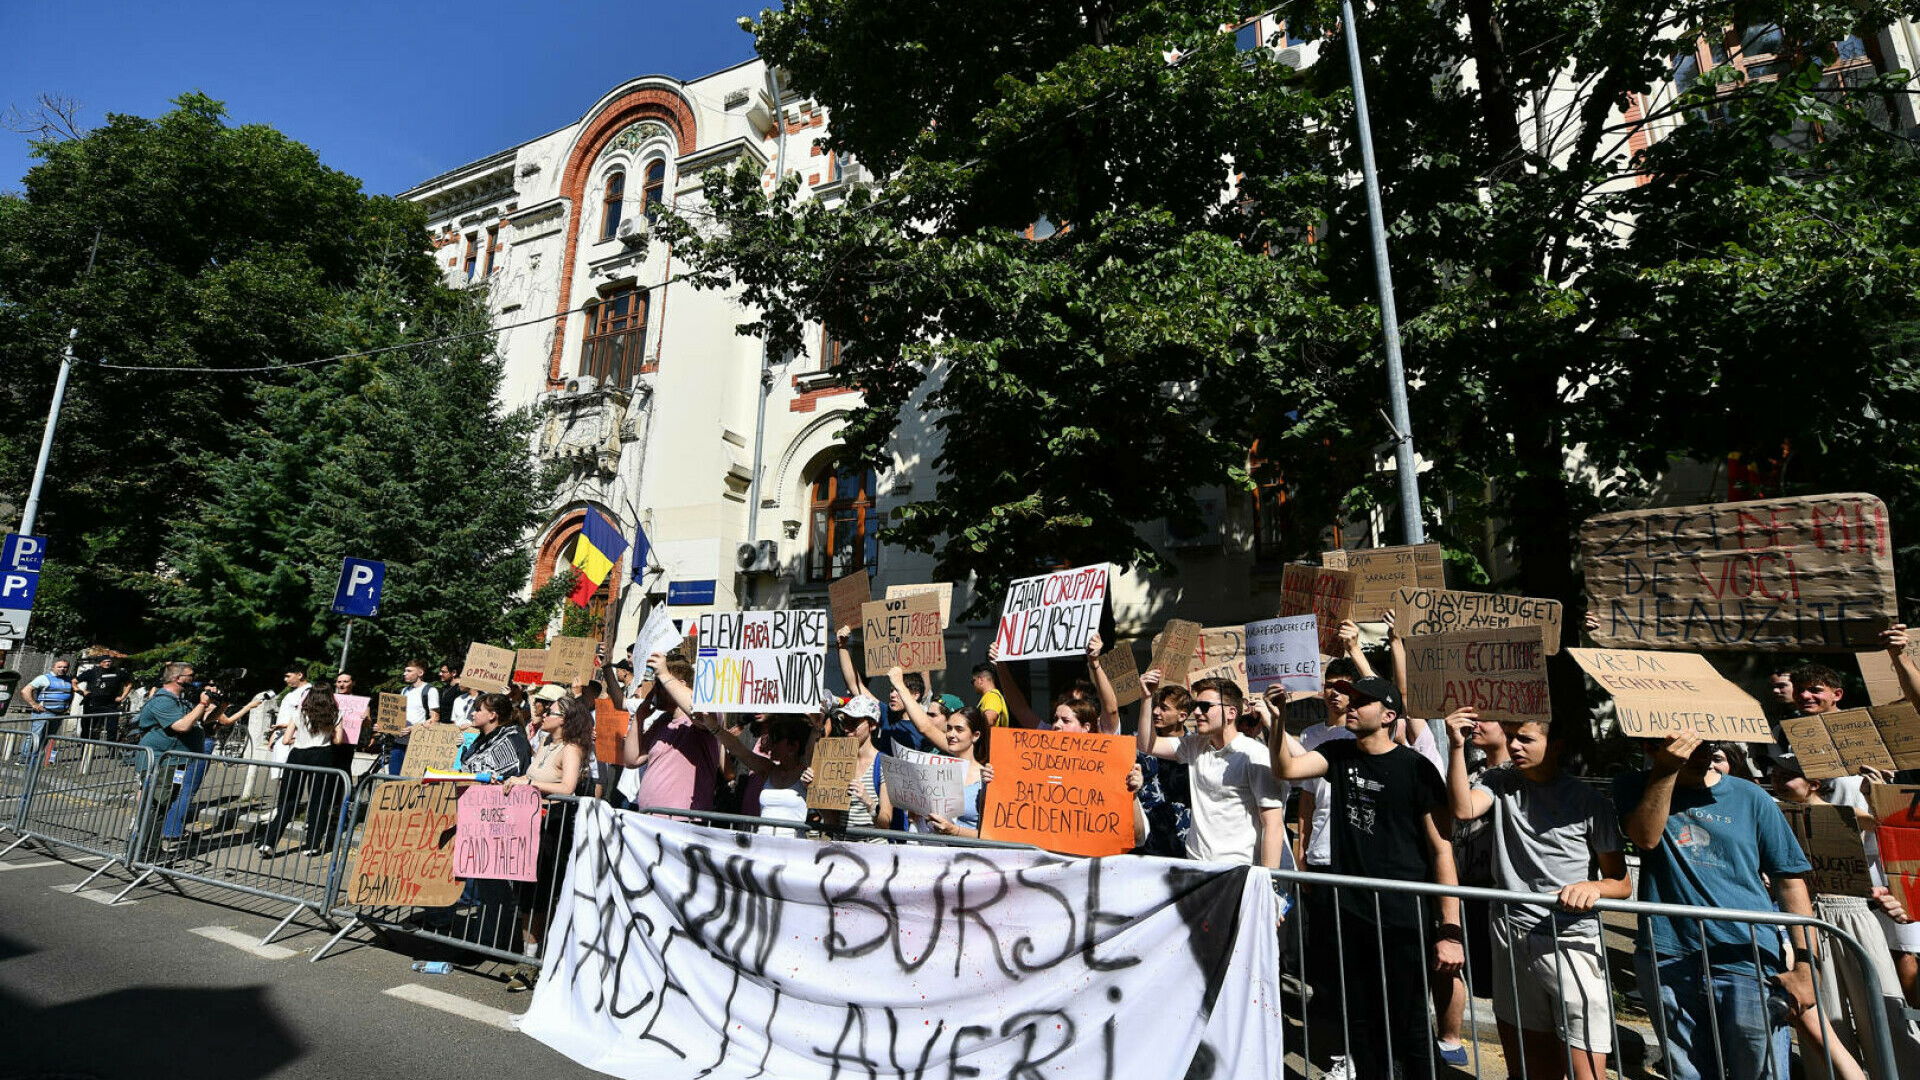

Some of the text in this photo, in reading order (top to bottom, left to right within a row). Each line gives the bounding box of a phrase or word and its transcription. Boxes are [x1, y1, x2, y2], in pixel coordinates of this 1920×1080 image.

[1598, 497, 1887, 560] ZECI DE MII
[12, 537, 38, 566] P
[2, 575, 28, 597] P
[346, 564, 374, 597] P
[1623, 556, 1677, 599] DE
[885, 600, 907, 612] VOI
[1467, 611, 1510, 627] AVEM
[698, 611, 744, 650] ELEVI
[772, 610, 826, 649] BURSE
[997, 603, 1101, 656] NU BURSELE
[1609, 598, 1875, 649] NEAUZITE
[1296, 660, 1316, 674] CE?
[1411, 649, 1461, 672] VREM
[1580, 651, 1666, 674] VREM
[775, 651, 822, 707] VIITOR
[1602, 673, 1701, 693] ECHITATE
[1412, 682, 1435, 710] NU
[1619, 707, 1773, 736] NU AUSTERITATE
[1013, 731, 1112, 754] PROBLEMELE
[823, 761, 852, 782] CERE
[937, 769, 953, 782] MII
[920, 785, 946, 797] VOCI
[1015, 780, 1105, 806] BATJOCURA
[480, 807, 506, 823] BURSE
[369, 812, 402, 850] NU
[401, 812, 423, 847] E
[358, 844, 420, 882] PENTRU
[814, 846, 1143, 986] BURSE
